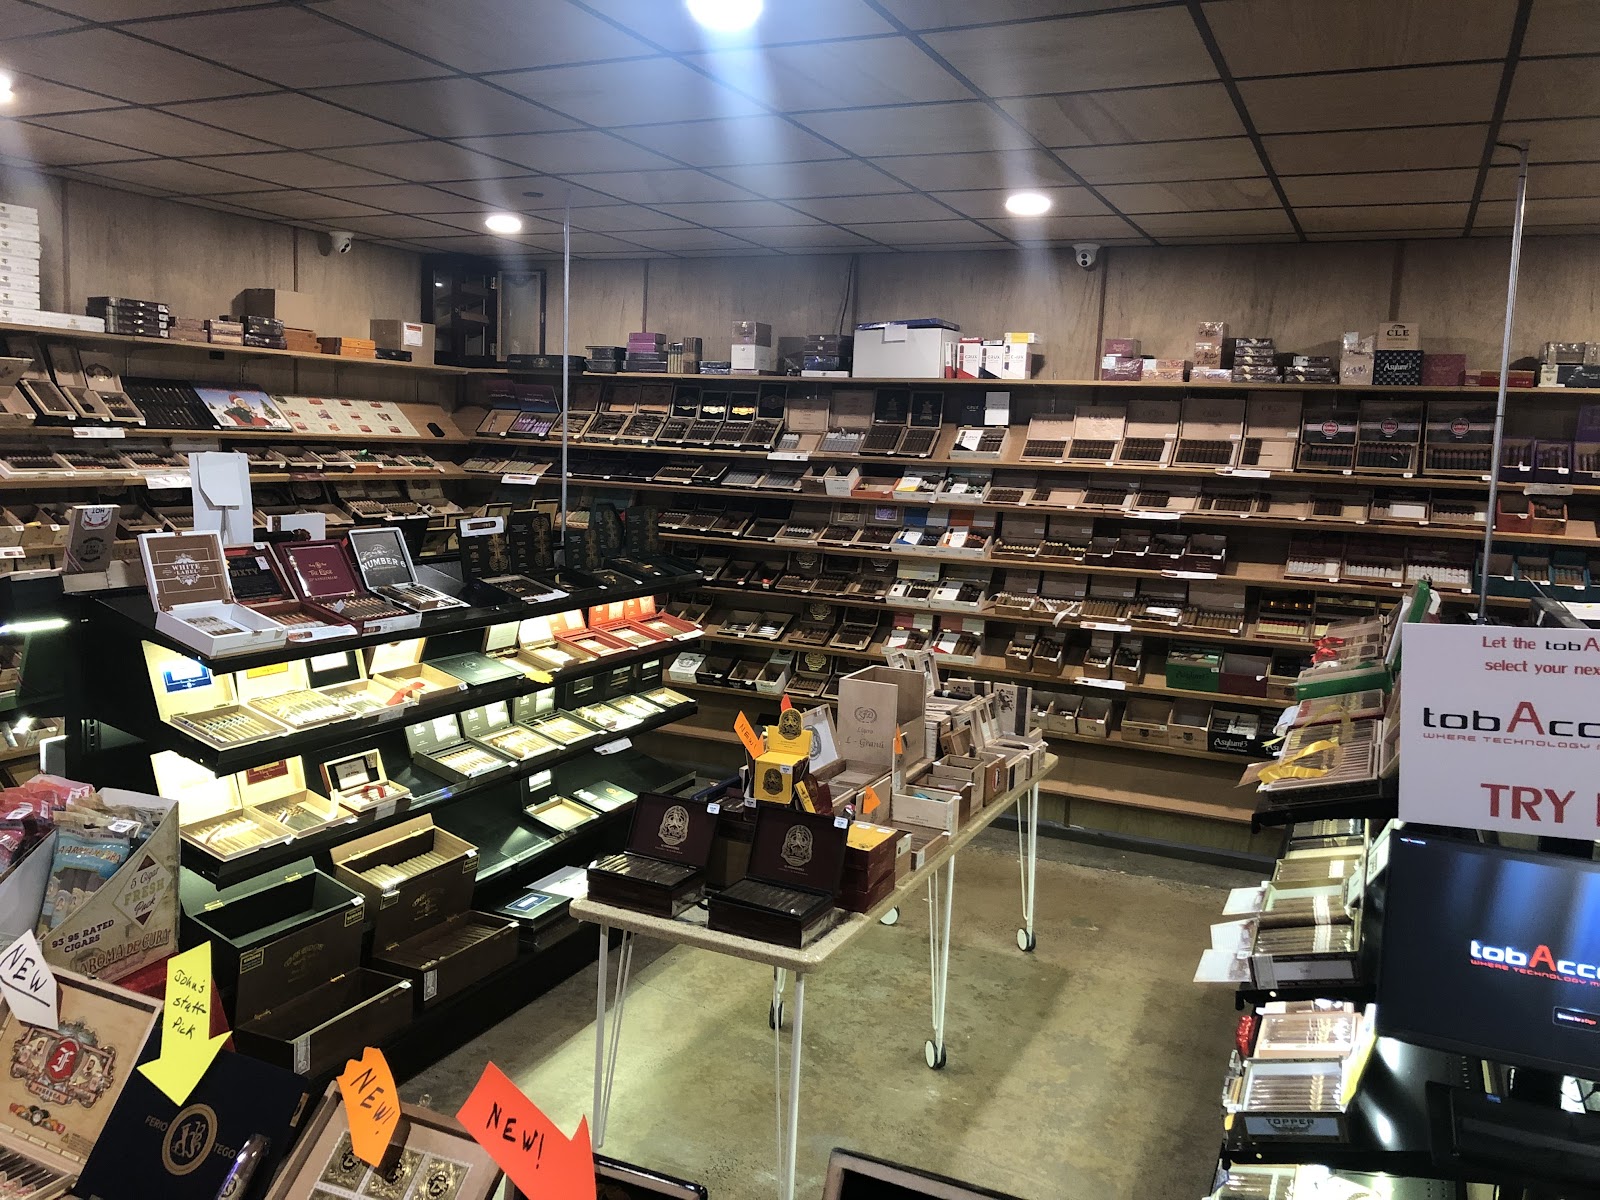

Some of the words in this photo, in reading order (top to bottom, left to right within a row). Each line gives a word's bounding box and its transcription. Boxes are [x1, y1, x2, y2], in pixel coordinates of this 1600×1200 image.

[1386, 329, 1410, 337] CLE
[171, 563, 201, 571] WHITE
[229, 567, 259, 578] SIXTY
[361, 557, 399, 572] NUMBER
[400, 560, 407, 568] 6
[1482, 636, 1507, 649] Let
[1513, 637, 1536, 650] the
[1485, 660, 1528, 673] select
[1534, 664, 1568, 676] your
[1423, 732, 1476, 742] WHERE
[1483, 736, 1591, 750] TECHNOLOGY
[1480, 783, 1576, 824] TRY
[140, 867, 160, 884] Cigar
[124, 877, 164, 906] FRESH
[134, 894, 156, 915] Pack
[52, 937, 64, 948] 93
[67, 932, 79, 943] 95
[82, 919, 115, 938] RATED
[64, 934, 101, 953] CIGARS
[80, 944, 126, 974] AROMA
[126, 940, 142, 956] DE
[141, 929, 171, 951] CUBA
[0, 943, 48, 993] NEW
[1470, 959, 1509, 971] WHERE
[1512, 966, 1587, 985] TECHNOLOGY
[174, 969, 206, 993] John's
[349, 1068, 396, 1135] NEW!
[145, 1115, 169, 1132] FERIO
[486, 1101, 545, 1170] NEW!
[213, 1142, 237, 1160] TEGO
